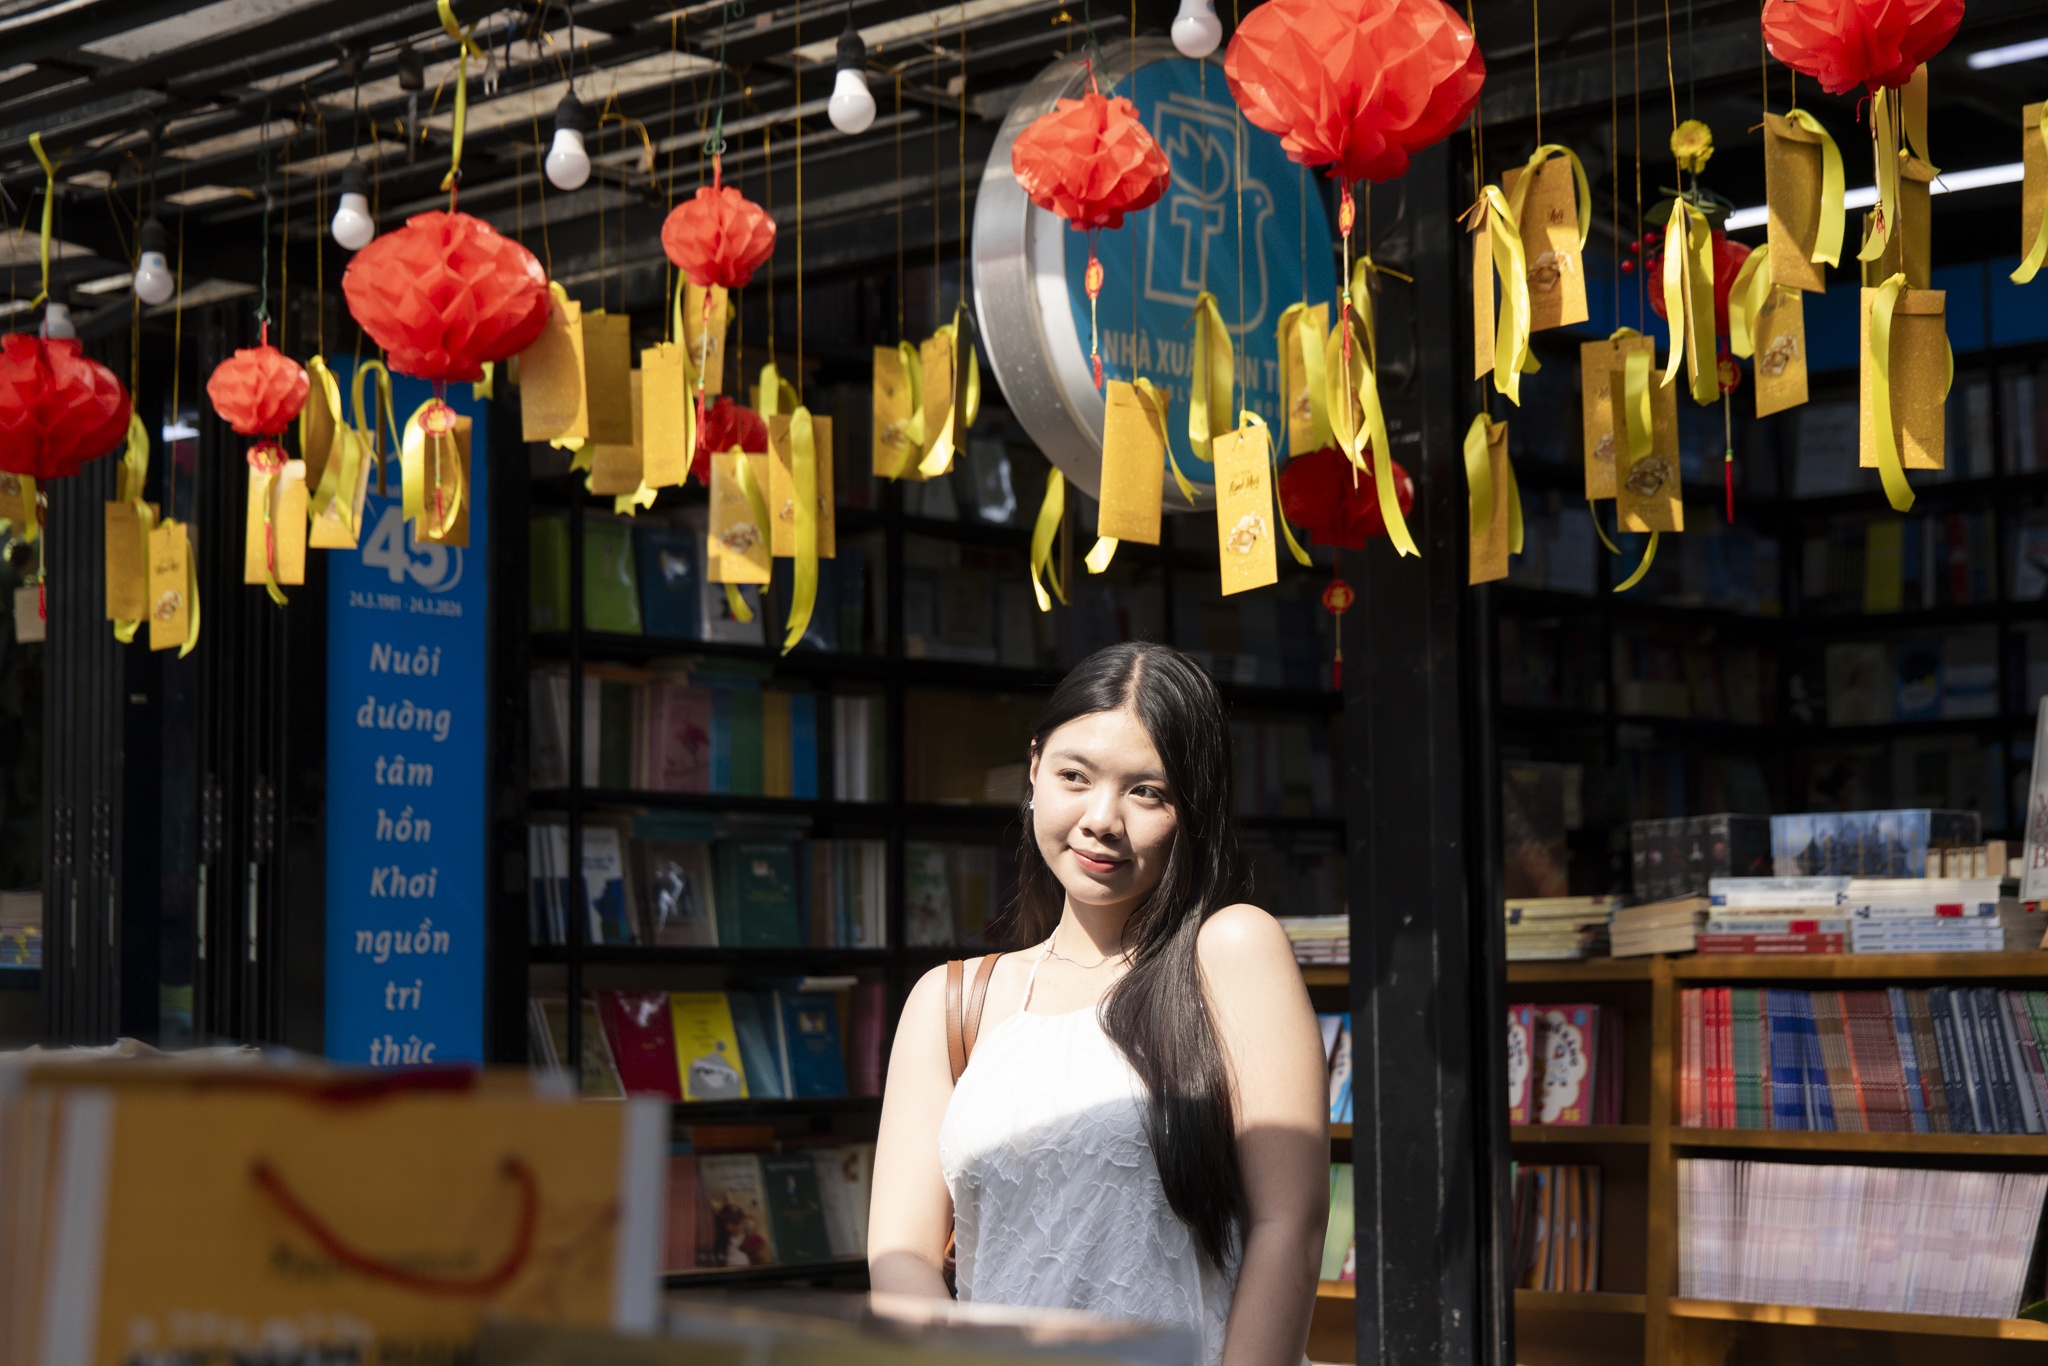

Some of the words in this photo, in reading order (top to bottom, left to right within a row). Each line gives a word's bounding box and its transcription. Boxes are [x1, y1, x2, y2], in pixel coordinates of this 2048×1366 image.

[1103, 328, 1152, 371] NHÀ
[362, 505, 449, 586] 45
[369, 641, 442, 677] Nuôi
[375, 754, 434, 787] tâm
[376, 805, 432, 842] hồn
[370, 865, 439, 898] Khơi
[355, 917, 451, 964] nguồn
[385, 978, 423, 1011] tri
[369, 1034, 436, 1066] thức
